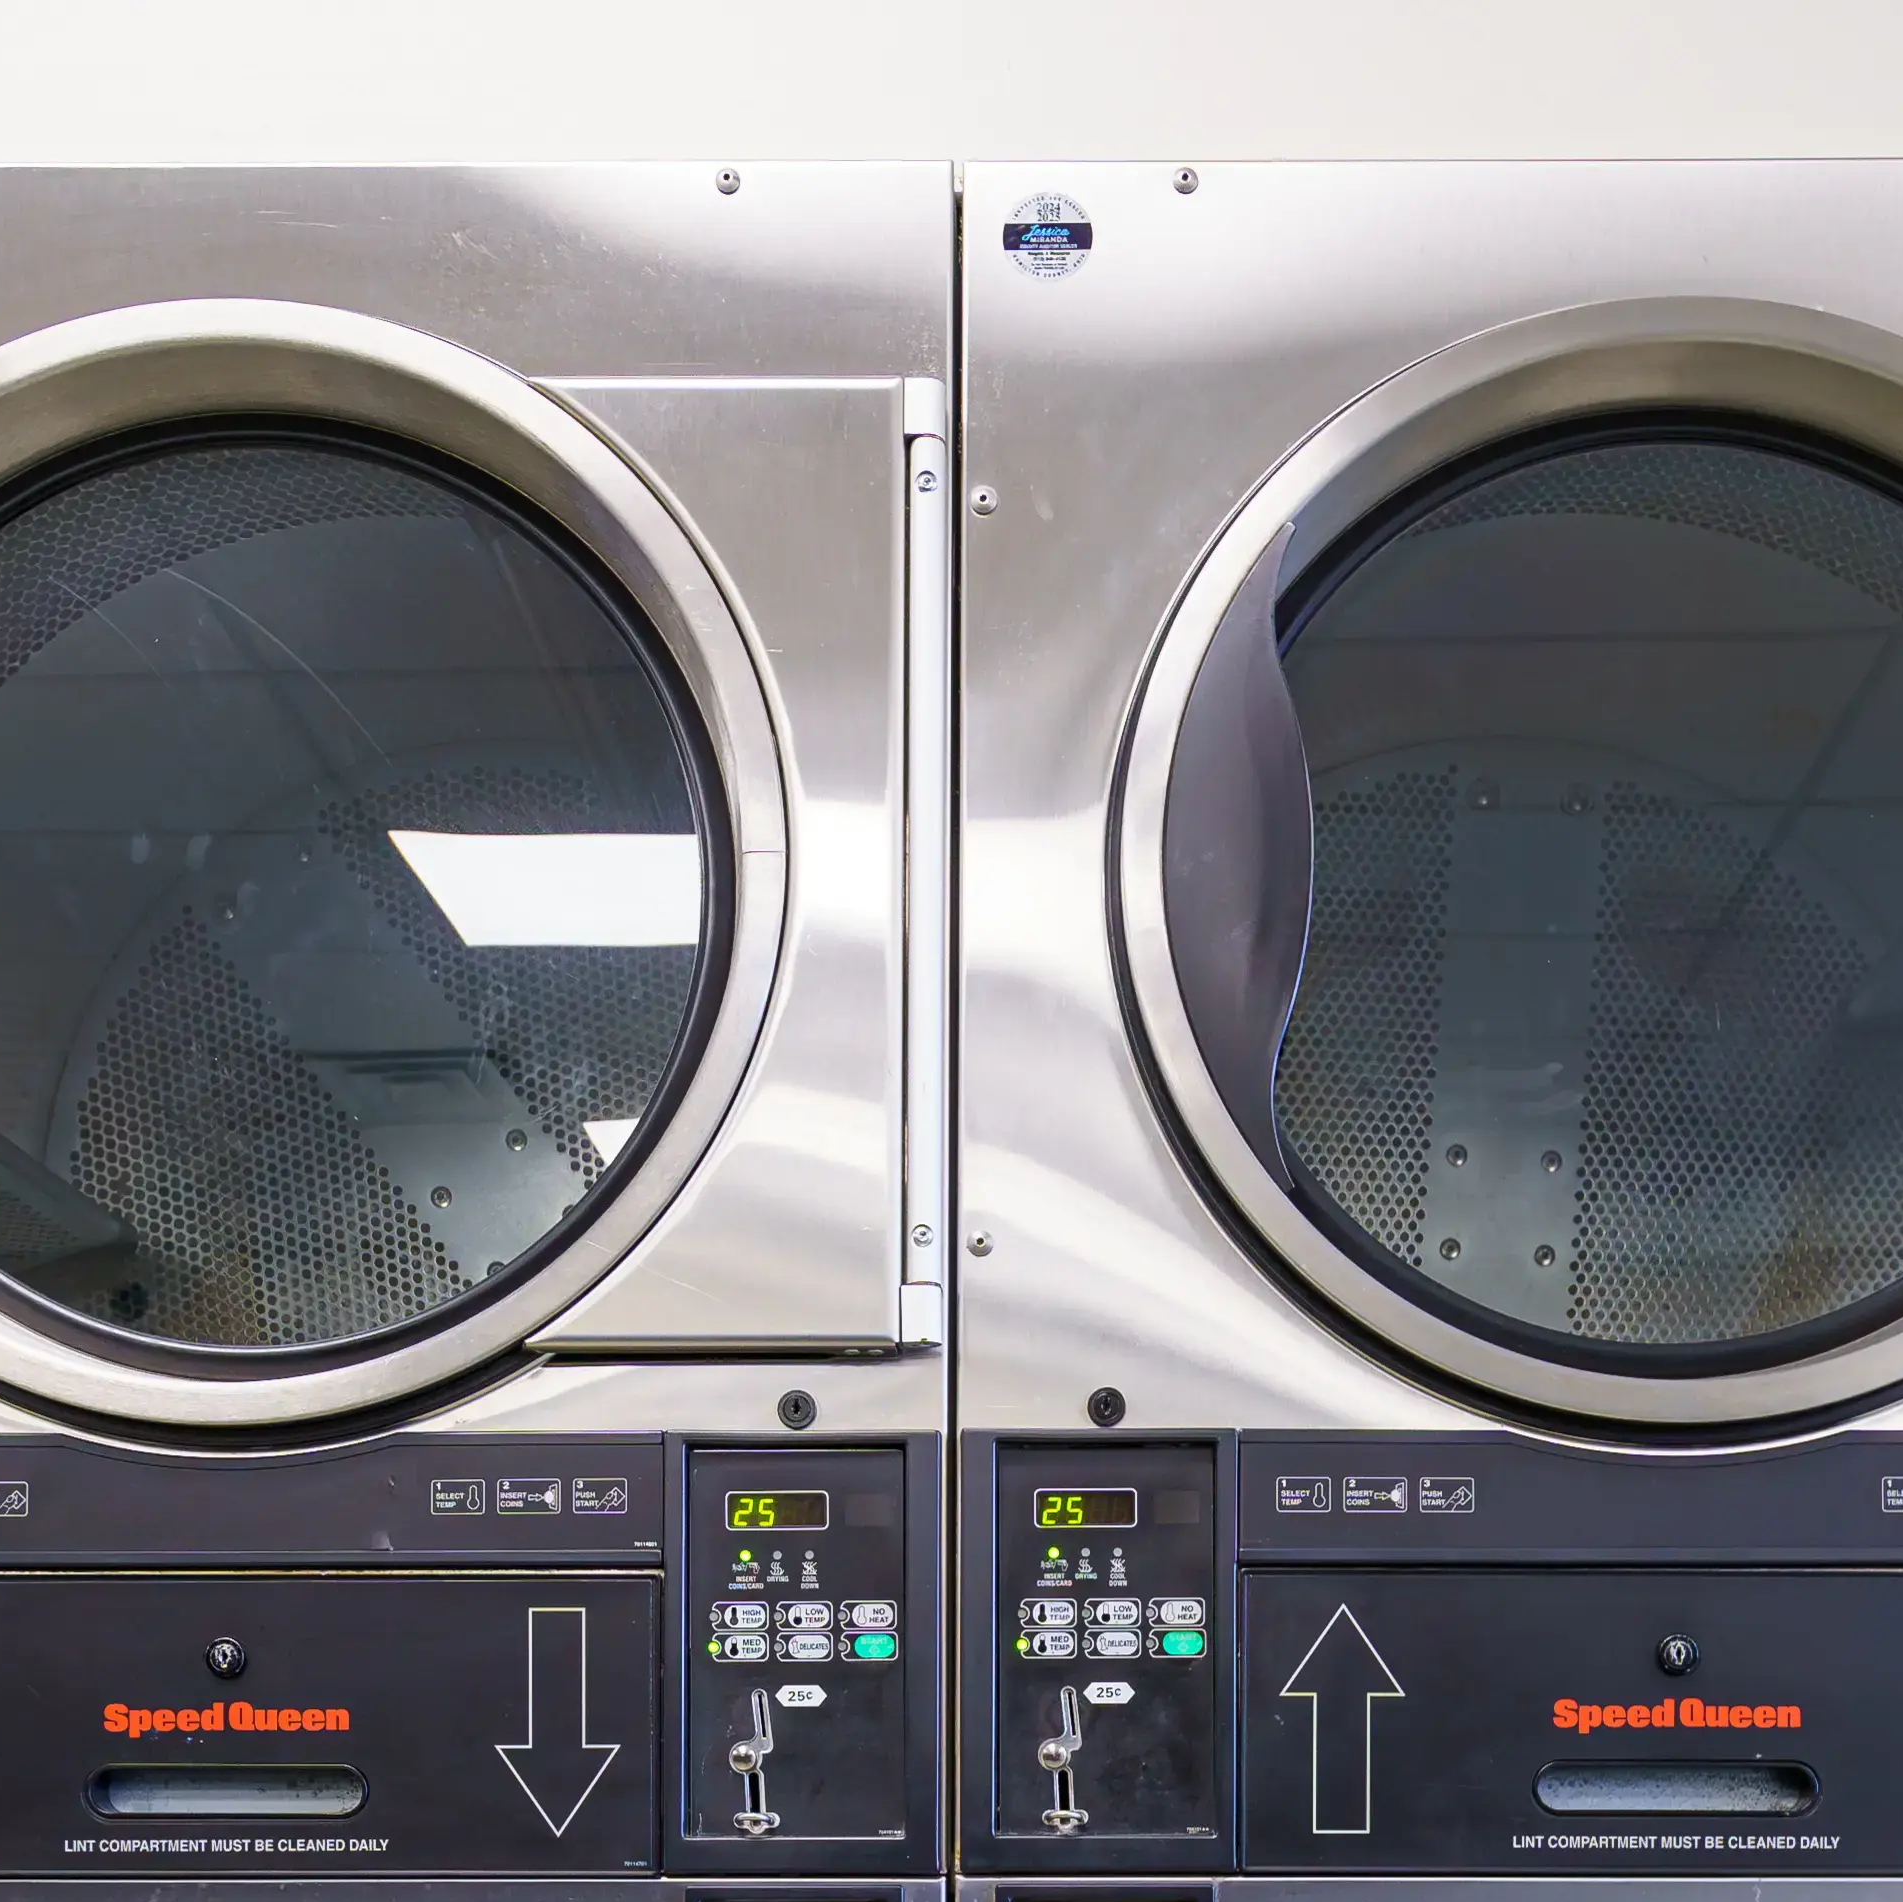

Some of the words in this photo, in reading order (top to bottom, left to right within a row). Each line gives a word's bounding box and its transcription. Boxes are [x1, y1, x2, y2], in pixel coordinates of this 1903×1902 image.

[1037, 203, 1061, 212] 2024
[1037, 212, 1061, 221] 2025
[1022, 225, 1070, 241] Jessica
[734, 1498, 774, 1526] 25
[1042, 1497, 1083, 1524] 25
[103, 1702, 224, 1738] Speed
[227, 1701, 350, 1731] Queen
[1553, 1698, 1675, 1734] Speed
[1679, 1697, 1801, 1728] Queen
[65, 1840, 96, 1852] LINT
[99, 1840, 207, 1852] COMPARTMENT
[212, 1839, 251, 1852] MUST
[255, 1839, 274, 1851] BE
[278, 1839, 345, 1851] CLEANED
[350, 1839, 389, 1851] DAILY
[1513, 1836, 1544, 1848] LINT
[1548, 1836, 1657, 1848] COMPARTMENT
[1661, 1836, 1701, 1849] MUST
[1705, 1836, 1724, 1848] BE
[1728, 1836, 1796, 1849] CLEANED
[1801, 1836, 1840, 1849] DAILY
